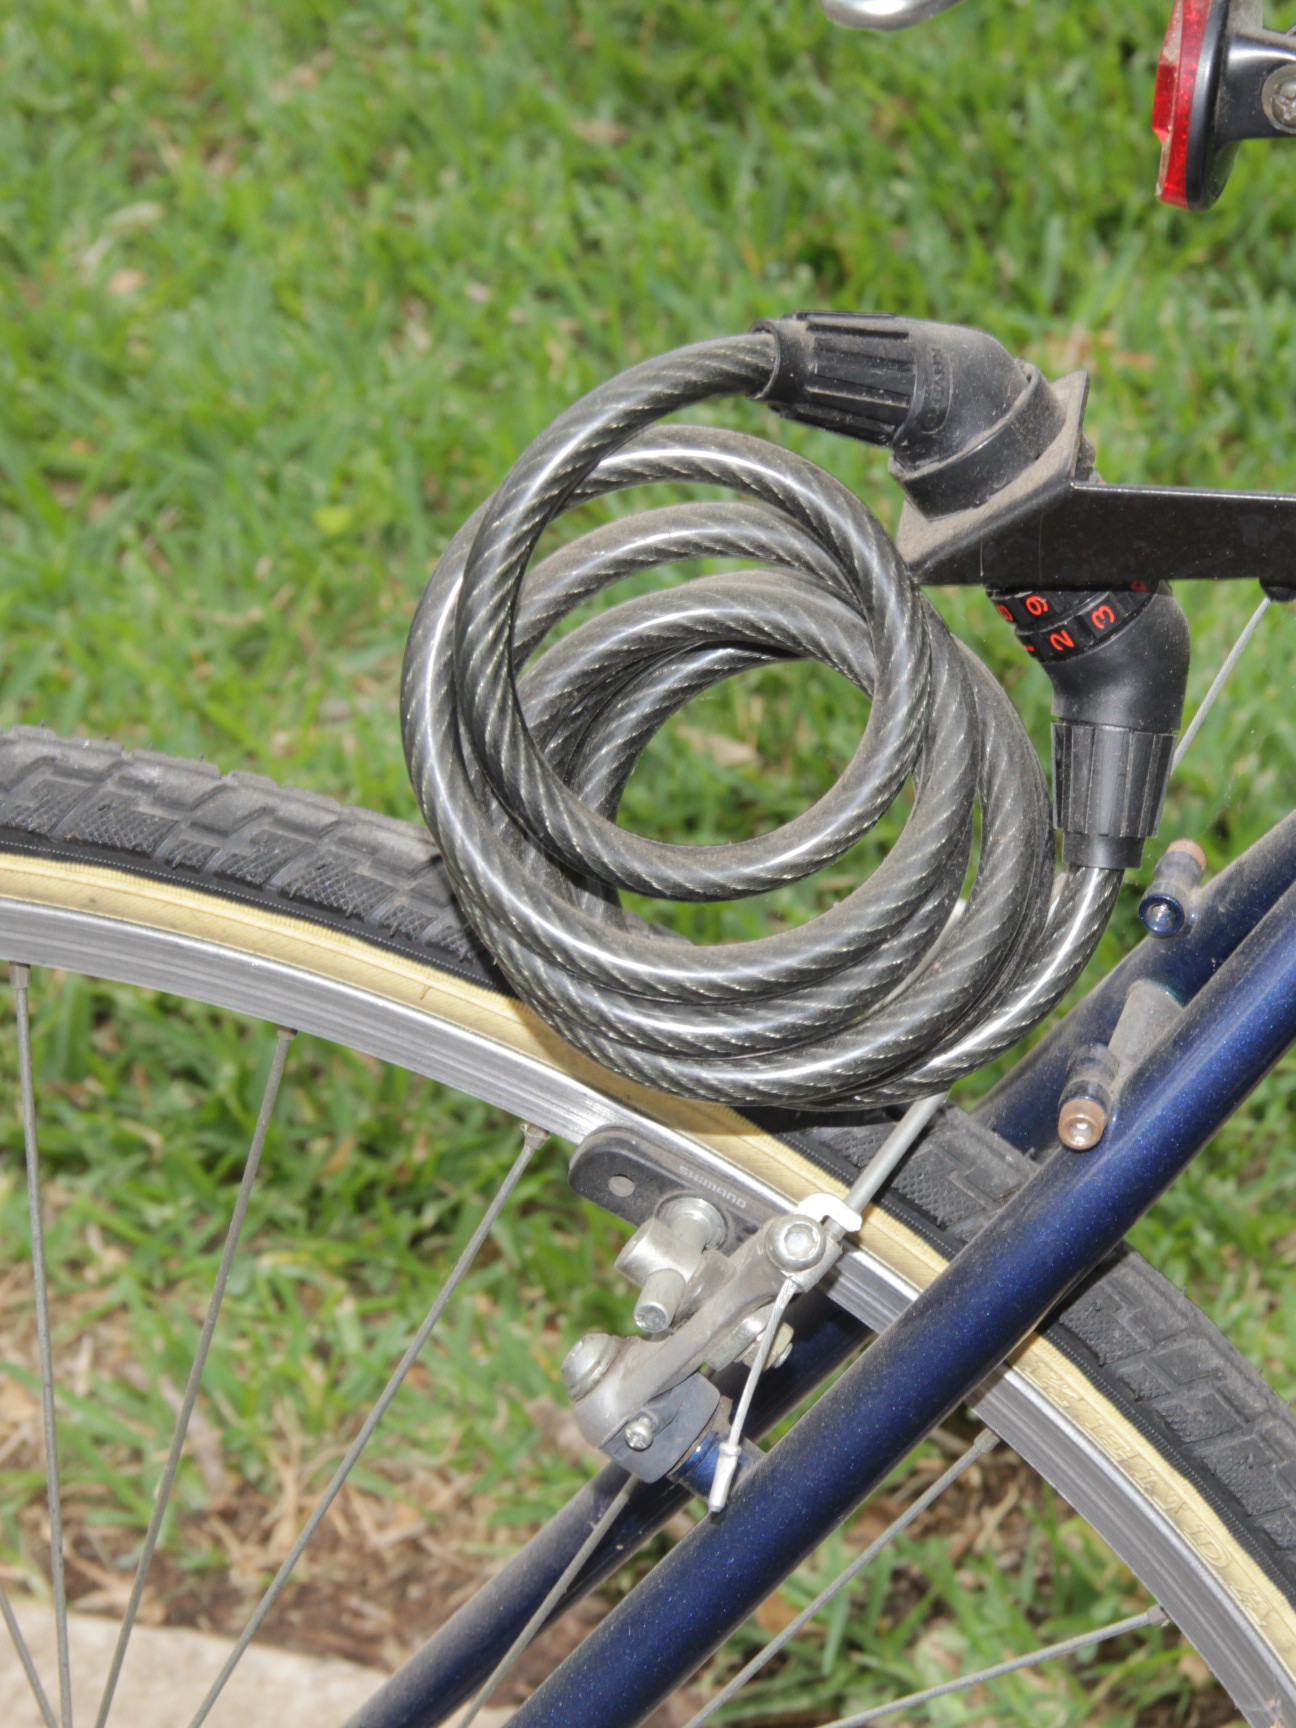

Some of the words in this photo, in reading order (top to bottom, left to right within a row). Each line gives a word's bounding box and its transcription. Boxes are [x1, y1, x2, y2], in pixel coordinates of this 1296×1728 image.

[1049, 629, 1075, 651] 2
[1091, 604, 1116, 630] 3
[680, 1165, 747, 1209] SHIMANO
